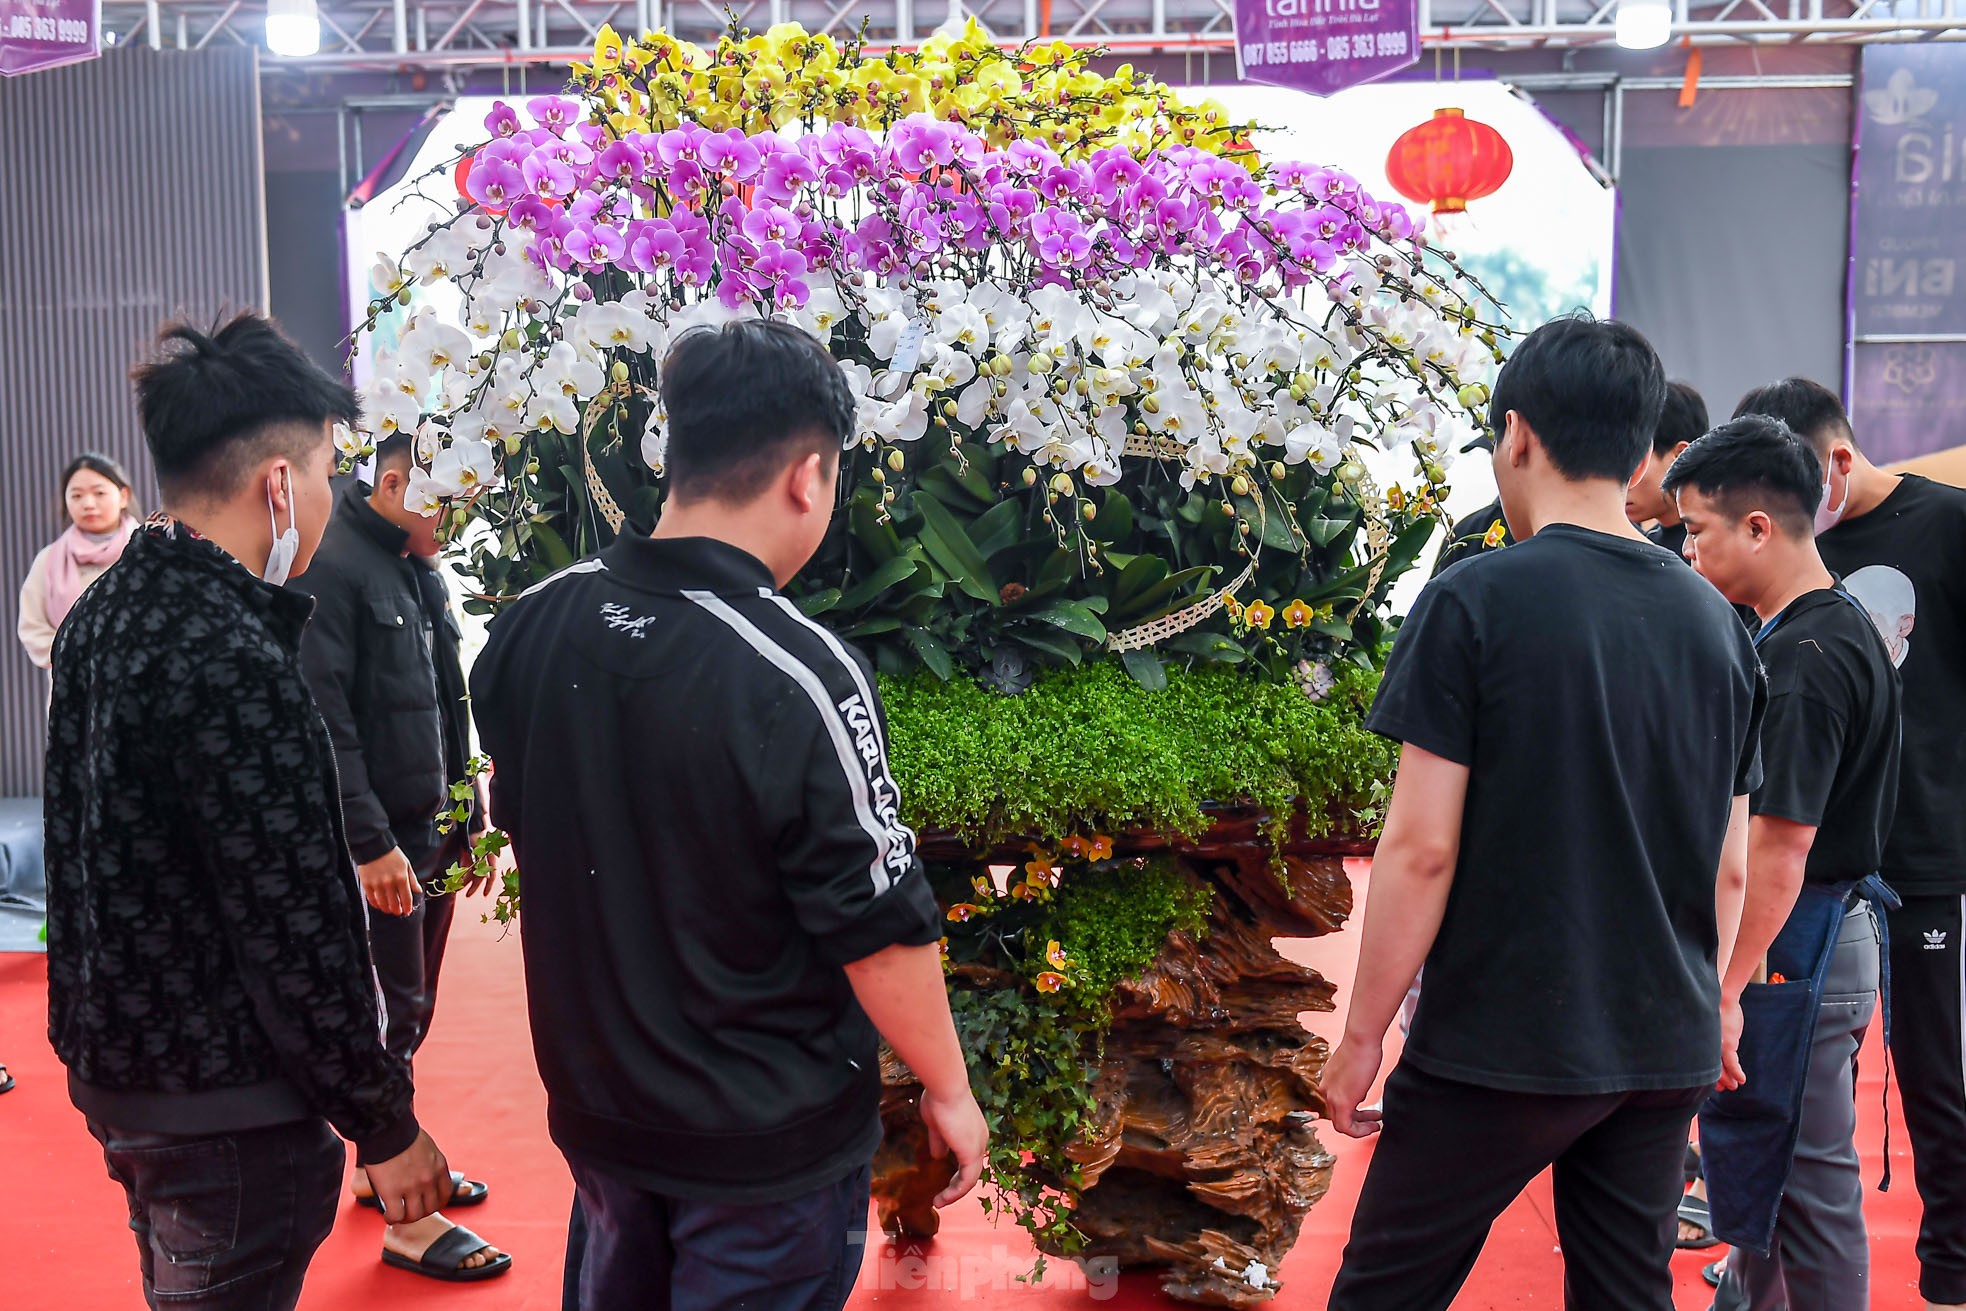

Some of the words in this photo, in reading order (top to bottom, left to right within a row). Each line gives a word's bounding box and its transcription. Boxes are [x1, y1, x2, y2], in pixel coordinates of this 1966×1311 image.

[58, 19, 88, 43] 9999
[1352, 34, 1375, 59] 363
[1377, 31, 1407, 56] 9999
[838, 693, 881, 780] KARL
